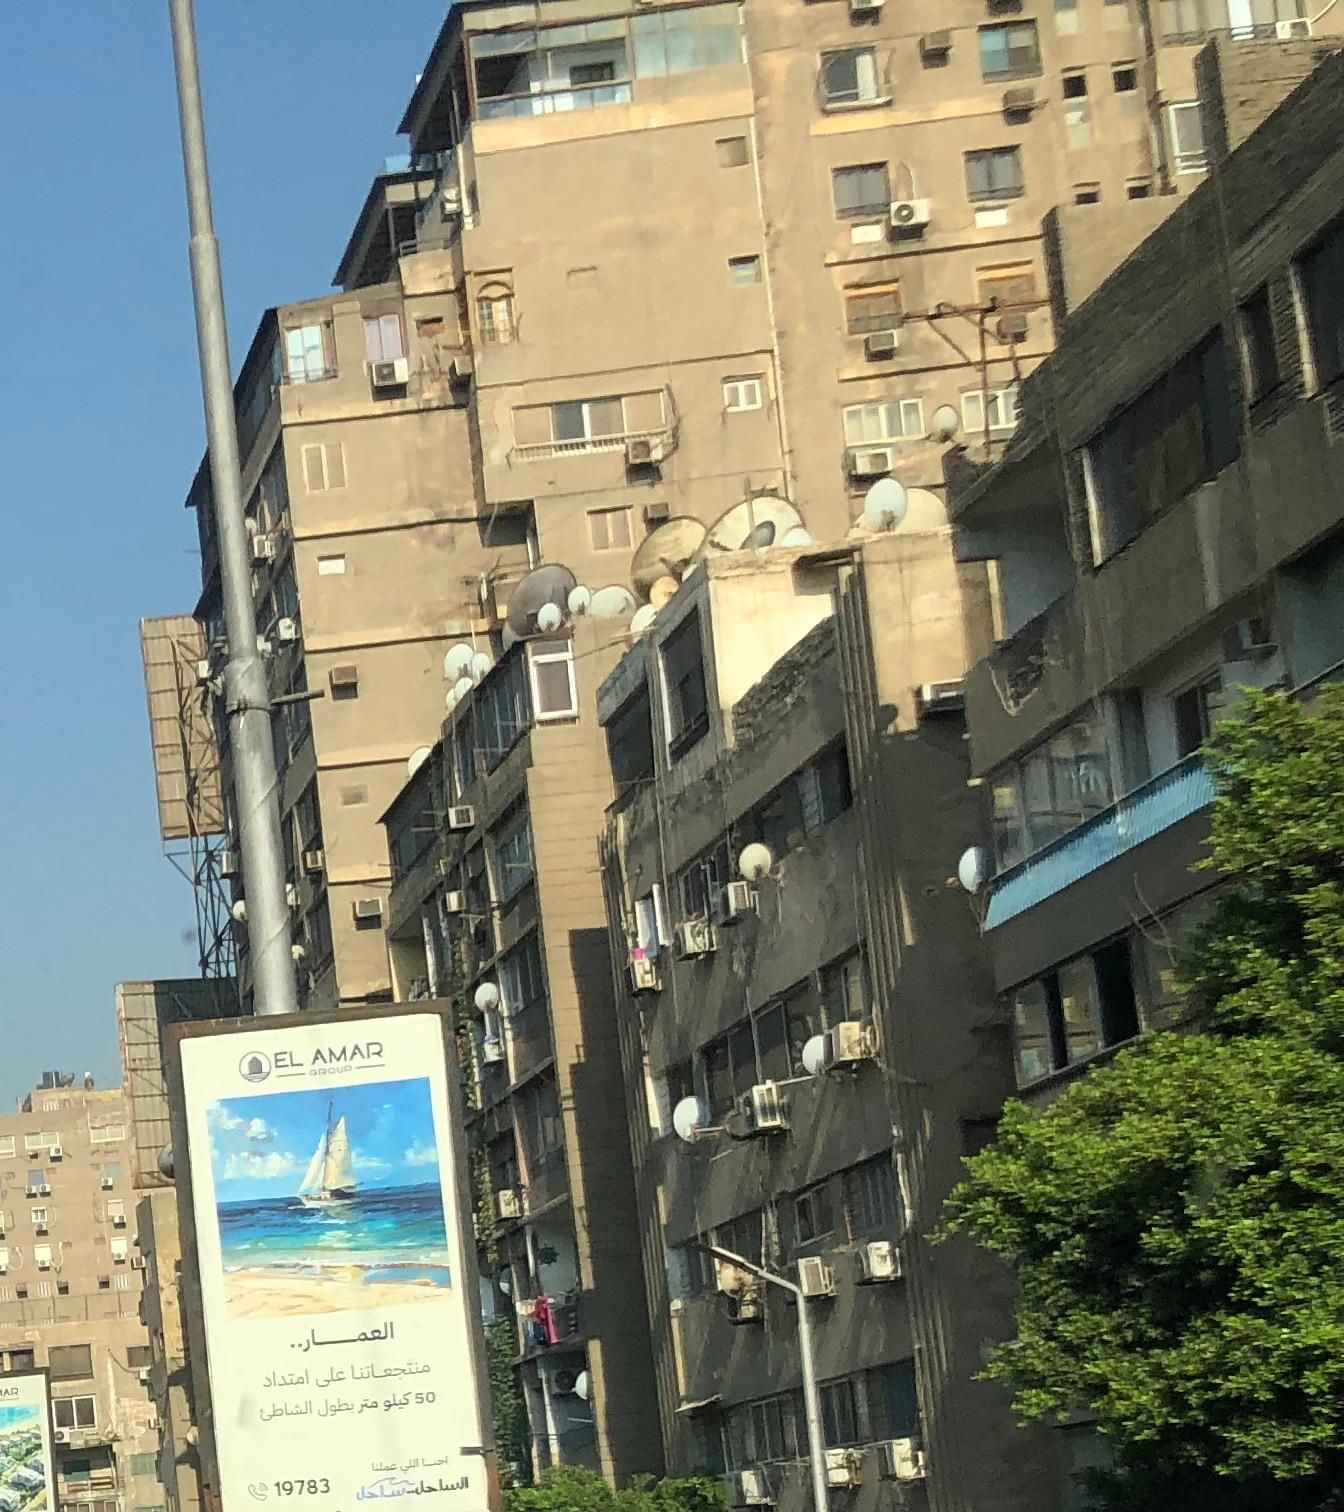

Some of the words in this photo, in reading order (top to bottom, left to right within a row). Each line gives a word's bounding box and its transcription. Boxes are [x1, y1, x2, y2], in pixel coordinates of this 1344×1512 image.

[274, 1051, 304, 1068] EL
[312, 1042, 383, 1065] AMAR
[263, 1369, 309, 1387] امتداد
[316, 1366, 346, 1387] على
[358, 1397, 378, 1413] متر
[383, 1392, 412, 1411] كيلو
[415, 1391, 436, 1404] 50
[317, 1398, 354, 1417] بطول
[274, 1478, 330, 1496] 19783
